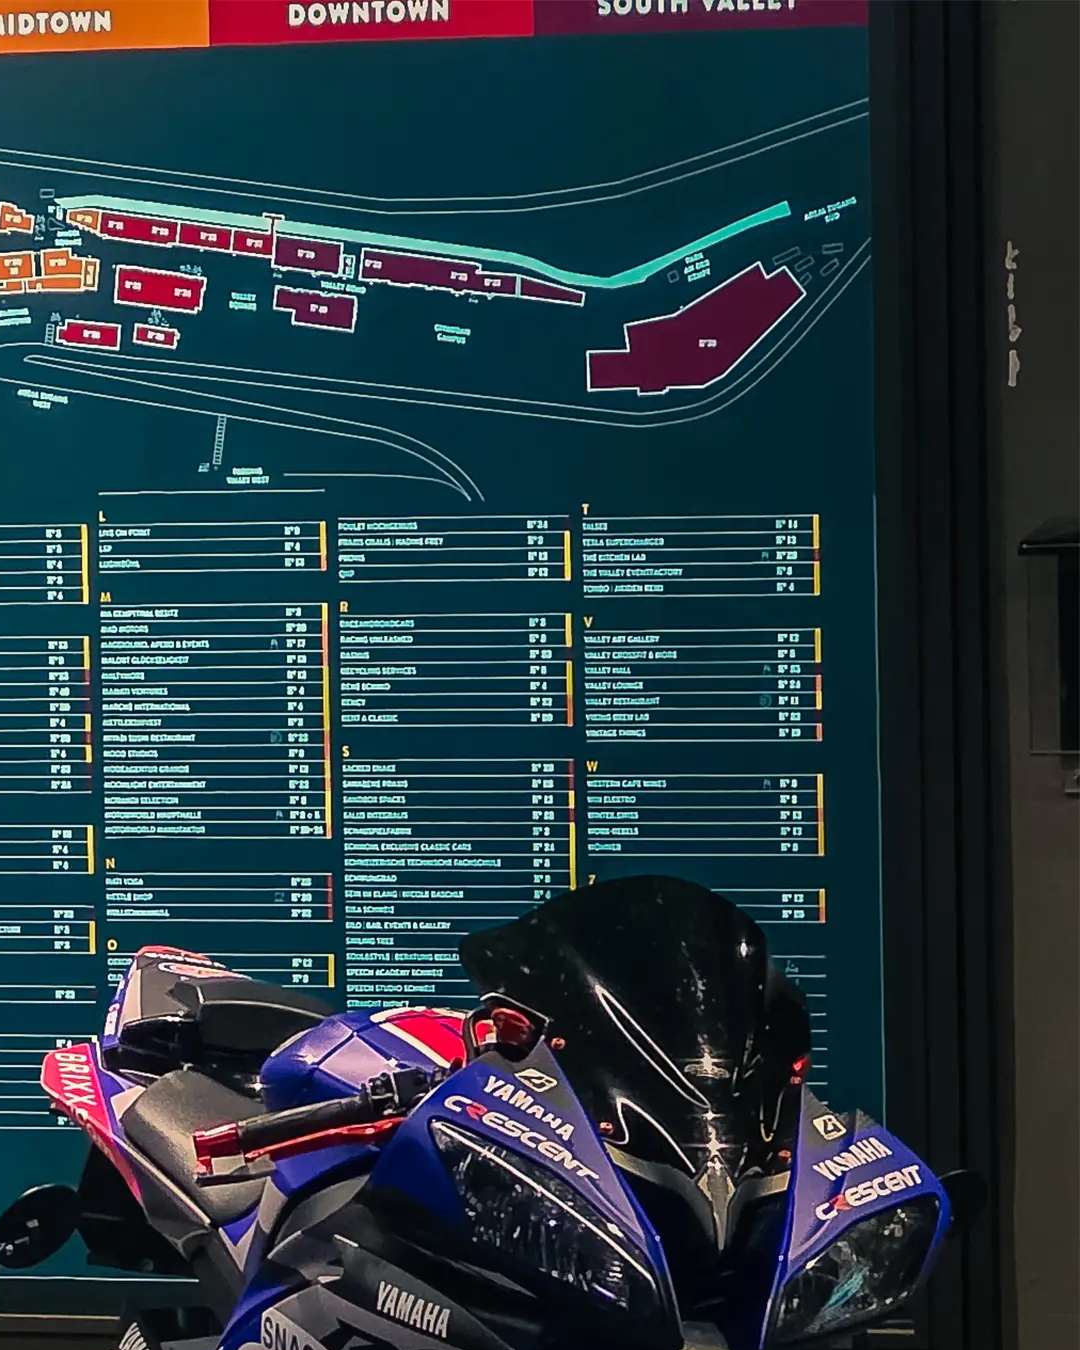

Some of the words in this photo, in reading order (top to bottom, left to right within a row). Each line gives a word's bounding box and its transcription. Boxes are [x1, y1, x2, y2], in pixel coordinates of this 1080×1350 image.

[289, 0, 448, 27] DOWNTOWN
[581, 503, 590, 516] T
[98, 510, 107, 523] L
[99, 591, 112, 603] M
[339, 600, 349, 613] R
[583, 616, 594, 628] V
[341, 745, 350, 758] S
[586, 760, 599, 772] W
[105, 857, 116, 870] N
[107, 938, 118, 951] O
[483, 1076, 575, 1141] YAMAHA
[444, 1095, 600, 1180] CRESCENT
[812, 1137, 893, 1182] YAMAHA
[815, 1164, 922, 1221] CRESCENT
[376, 1281, 452, 1338] YAMAHA
